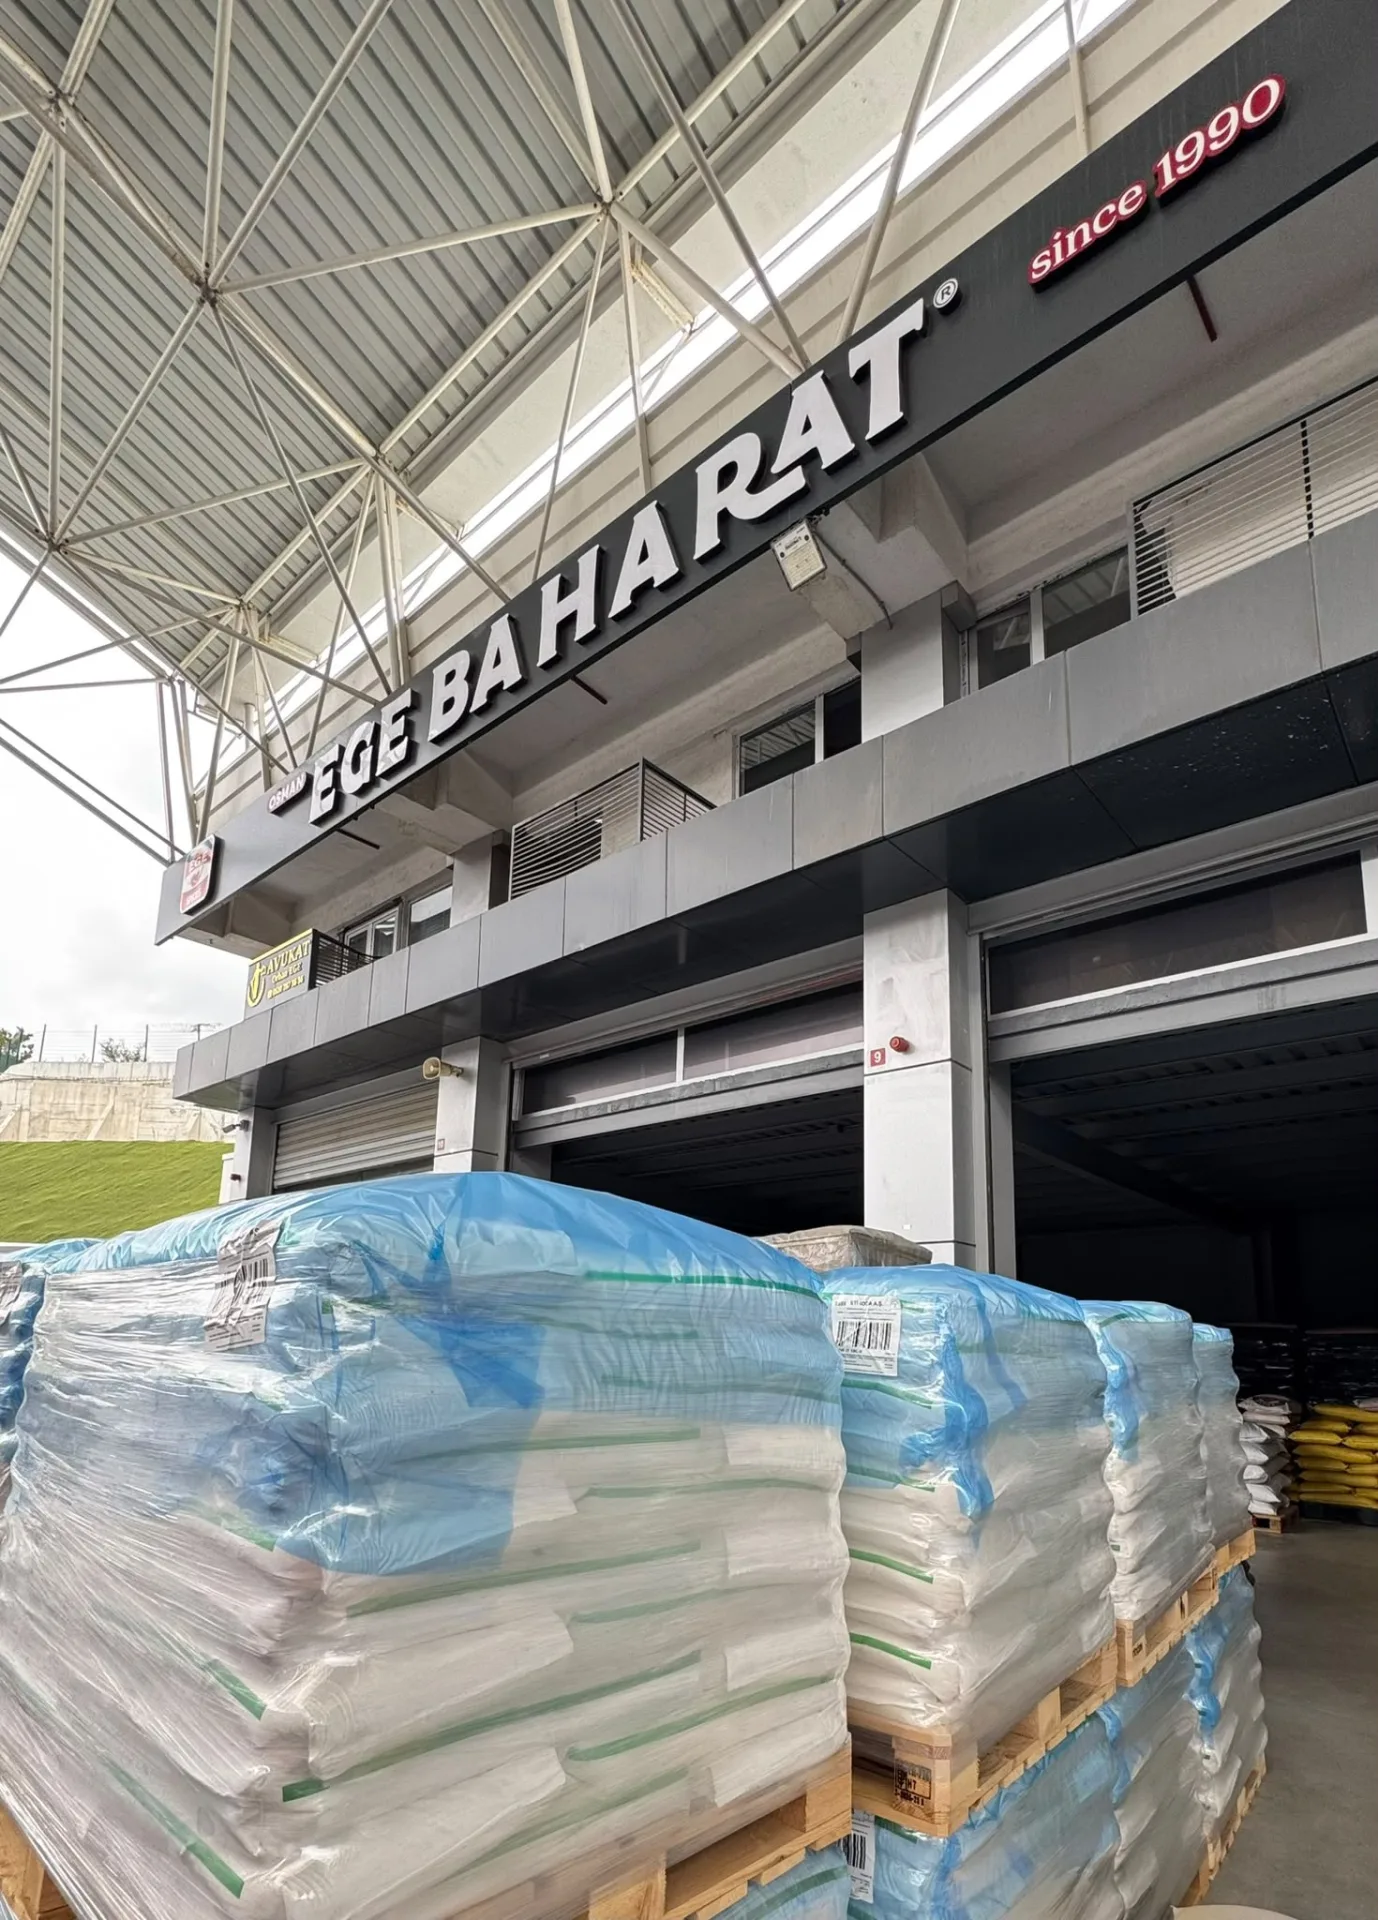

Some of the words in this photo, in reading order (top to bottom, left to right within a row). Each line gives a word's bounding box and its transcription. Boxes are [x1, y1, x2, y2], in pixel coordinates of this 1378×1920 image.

[1031, 184, 1144, 280] since
[1156, 78, 1281, 190] 1990
[309, 688, 412, 824] EGE
[427, 297, 924, 742] BAHARAT
[268, 771, 307, 810] OSMAN
[266, 940, 311, 975] AVUKAT
[873, 1050, 882, 1064] 9
